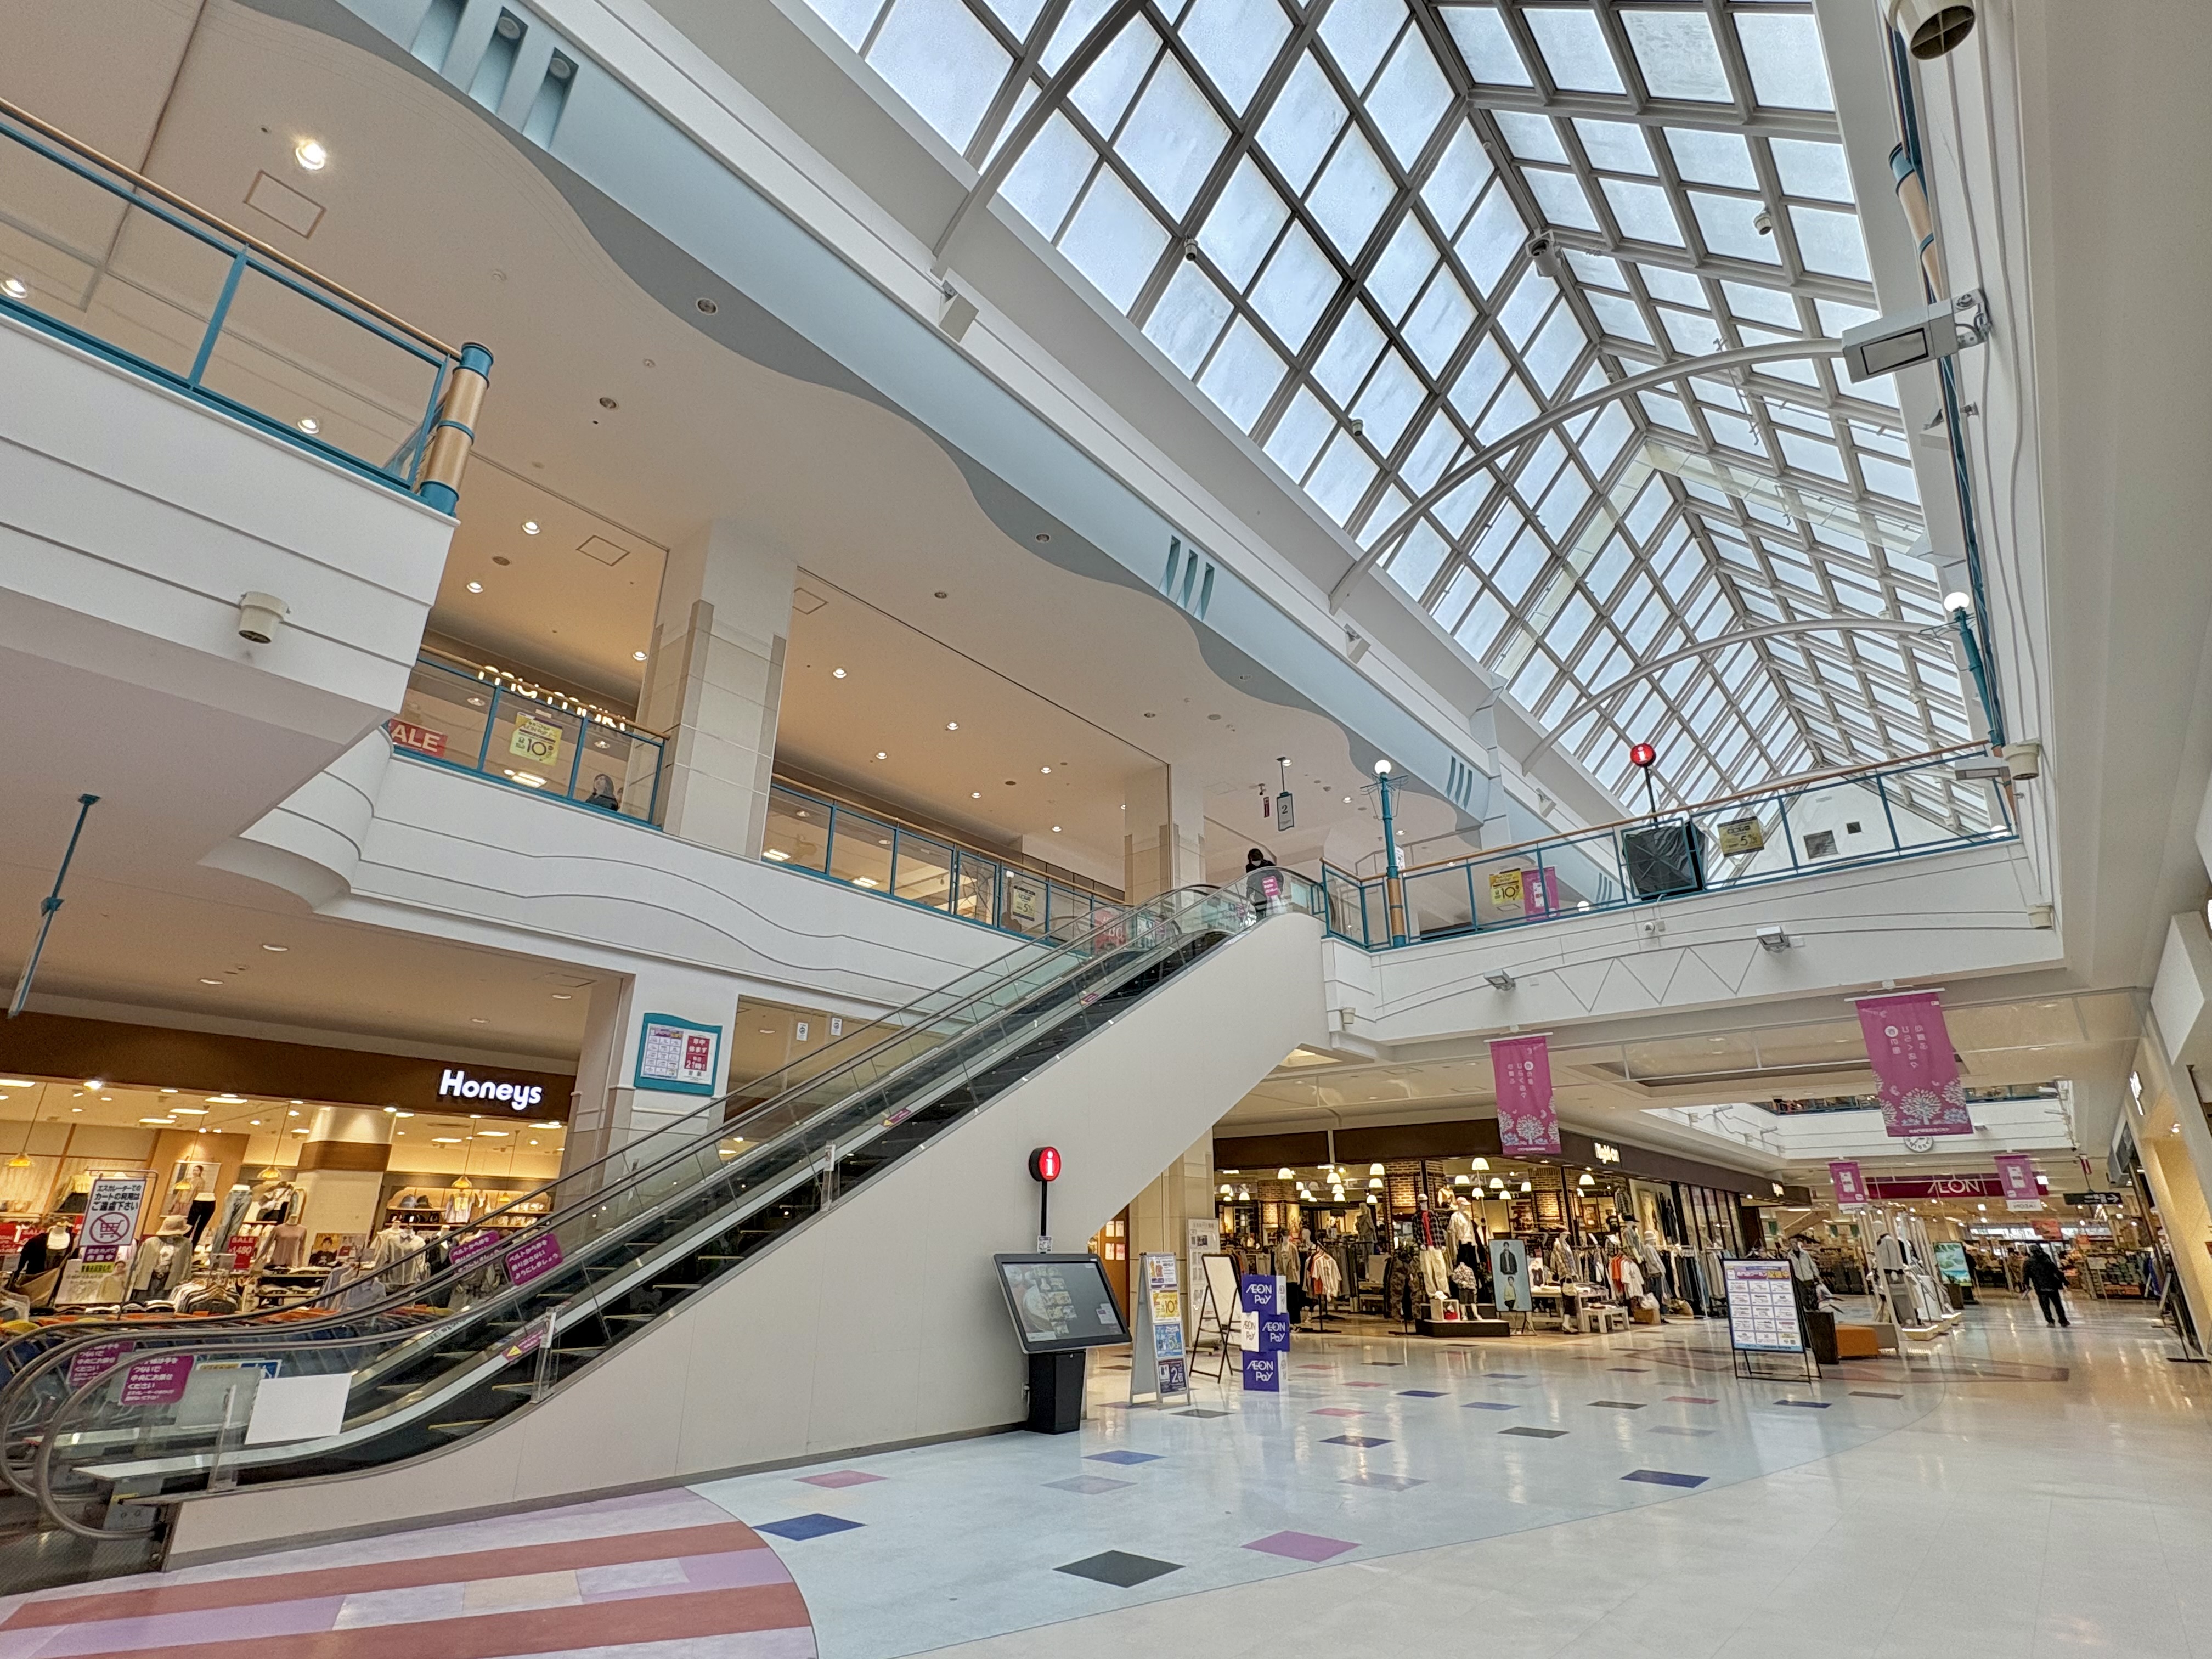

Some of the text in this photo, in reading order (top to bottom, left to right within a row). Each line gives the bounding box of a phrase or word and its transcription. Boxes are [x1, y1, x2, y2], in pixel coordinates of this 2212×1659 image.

[389, 723, 441, 753] ALE
[1282, 804, 1288, 814] 2
[439, 1069, 542, 1111] Honeys
[94, 1193, 140, 1201] カートの利用は
[91, 1201, 138, 1211] ご遠慮下さい
[1254, 1295, 1271, 1305] Pay
[1270, 1333, 1285, 1342] Pay
[1256, 1372, 1273, 1382] Pay
